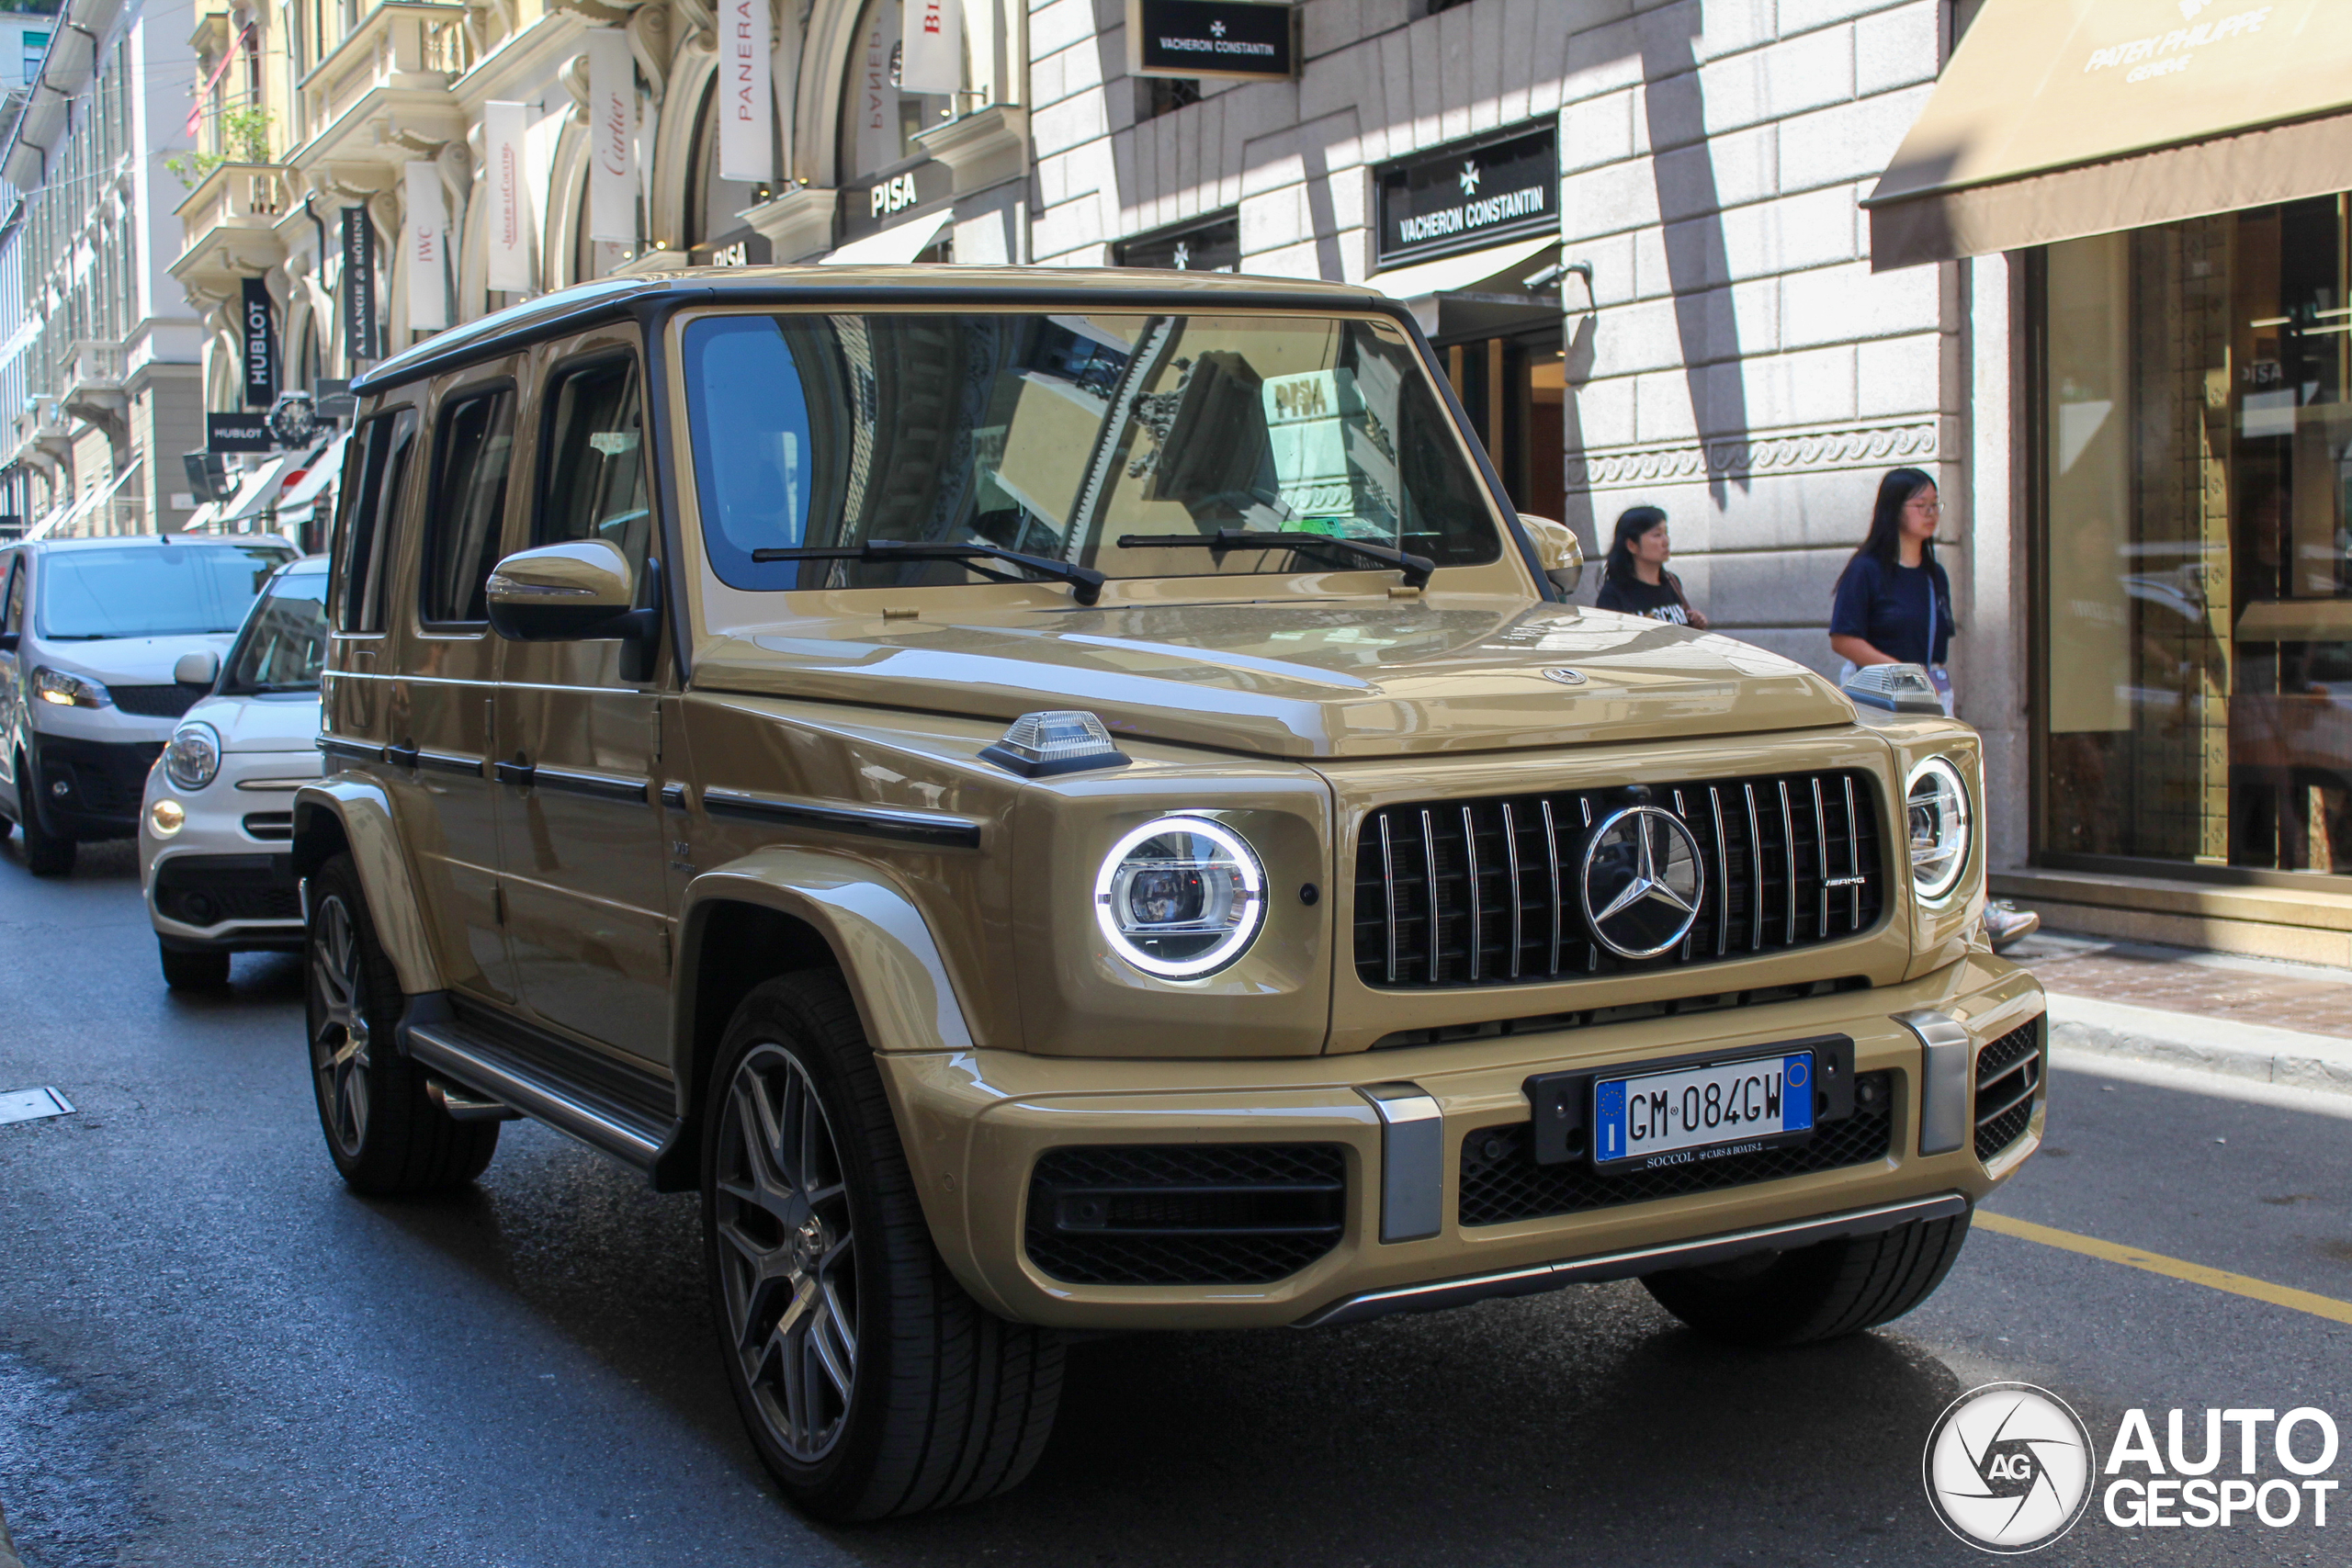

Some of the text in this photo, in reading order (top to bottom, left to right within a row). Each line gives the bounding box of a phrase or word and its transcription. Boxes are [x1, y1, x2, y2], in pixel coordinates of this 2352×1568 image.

[737, 1, 753, 121] PANERA
[1159, 37, 1274, 55] VACHERON CONSTANTIN
[2084, 6, 2273, 73] PATEK PHILIPPE
[601, 92, 626, 175] Cartier
[871, 172, 917, 219] PISA
[1399, 185, 1544, 243] VACHERON CONSTANTIN
[418, 226, 434, 262] IWC
[249, 300, 268, 385] HUBLOT
[214, 428, 263, 439] HUBLOT
[1838, 876, 1865, 886] AMG
[1646, 1143, 1757, 1168] SOCCOL CARS & BOATS
